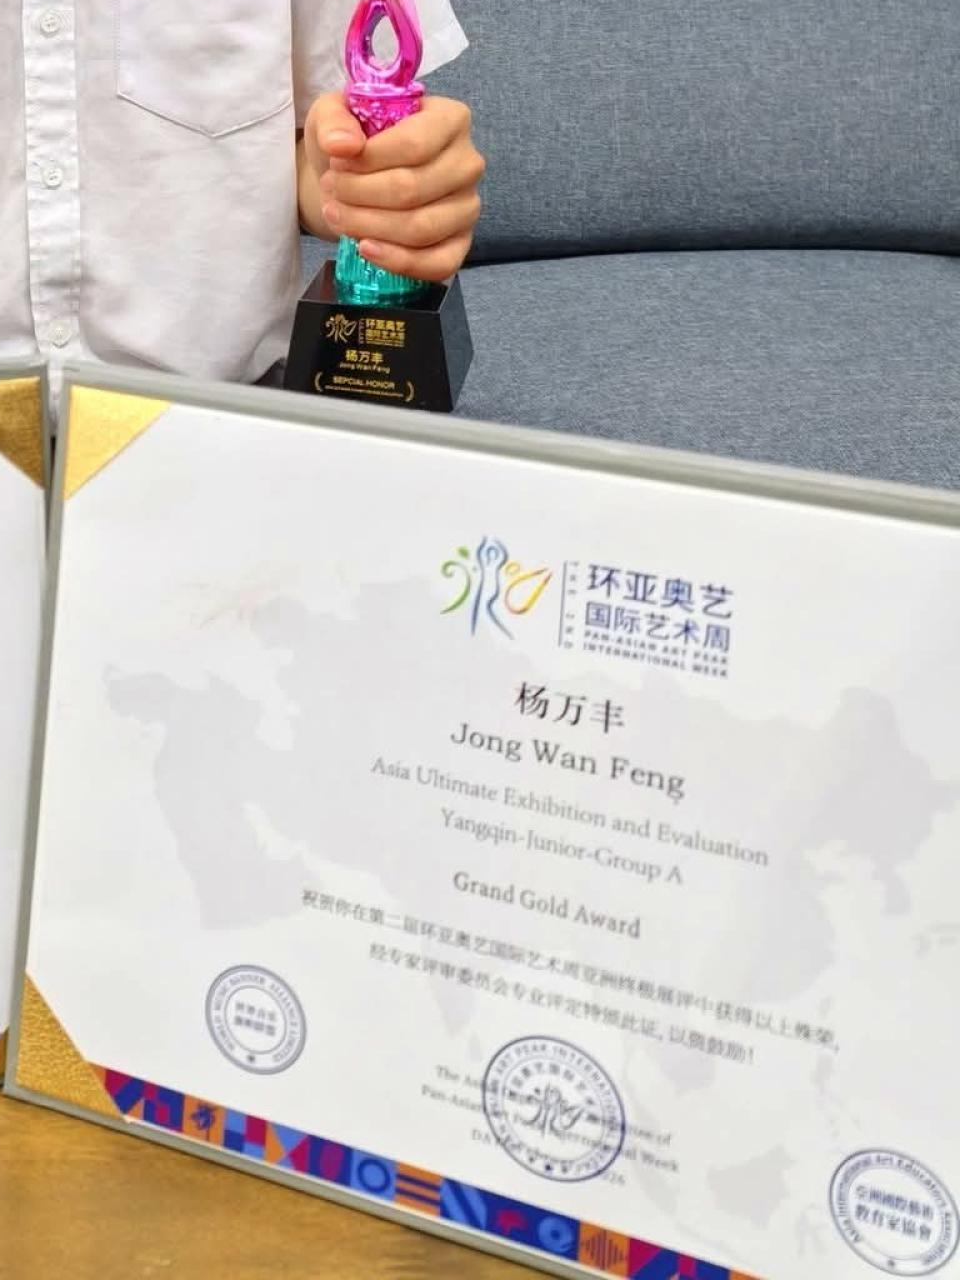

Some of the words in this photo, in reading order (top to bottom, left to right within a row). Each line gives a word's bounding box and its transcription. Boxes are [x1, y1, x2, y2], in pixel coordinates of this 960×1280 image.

[588, 564, 734, 620] 环亚奥艺
[585, 601, 731, 653] 国际艺术周
[514, 680, 626, 734] 杨万丰
[450, 723, 523, 762] Jong
[532, 738, 598, 775] Wan
[609, 757, 686, 800] Feng
[371, 756, 411, 781] Asia
[416, 765, 499, 802] Ultimate
[503, 787, 607, 828] Exhibition
[611, 816, 651, 840] and
[656, 824, 769, 868] Evaluation
[440, 807, 662, 882] Yangqin-Junior-Group
[665, 864, 684, 885] A
[452, 871, 515, 904] Grand
[519, 889, 570, 920] Gold
[573, 905, 642, 939] Award
